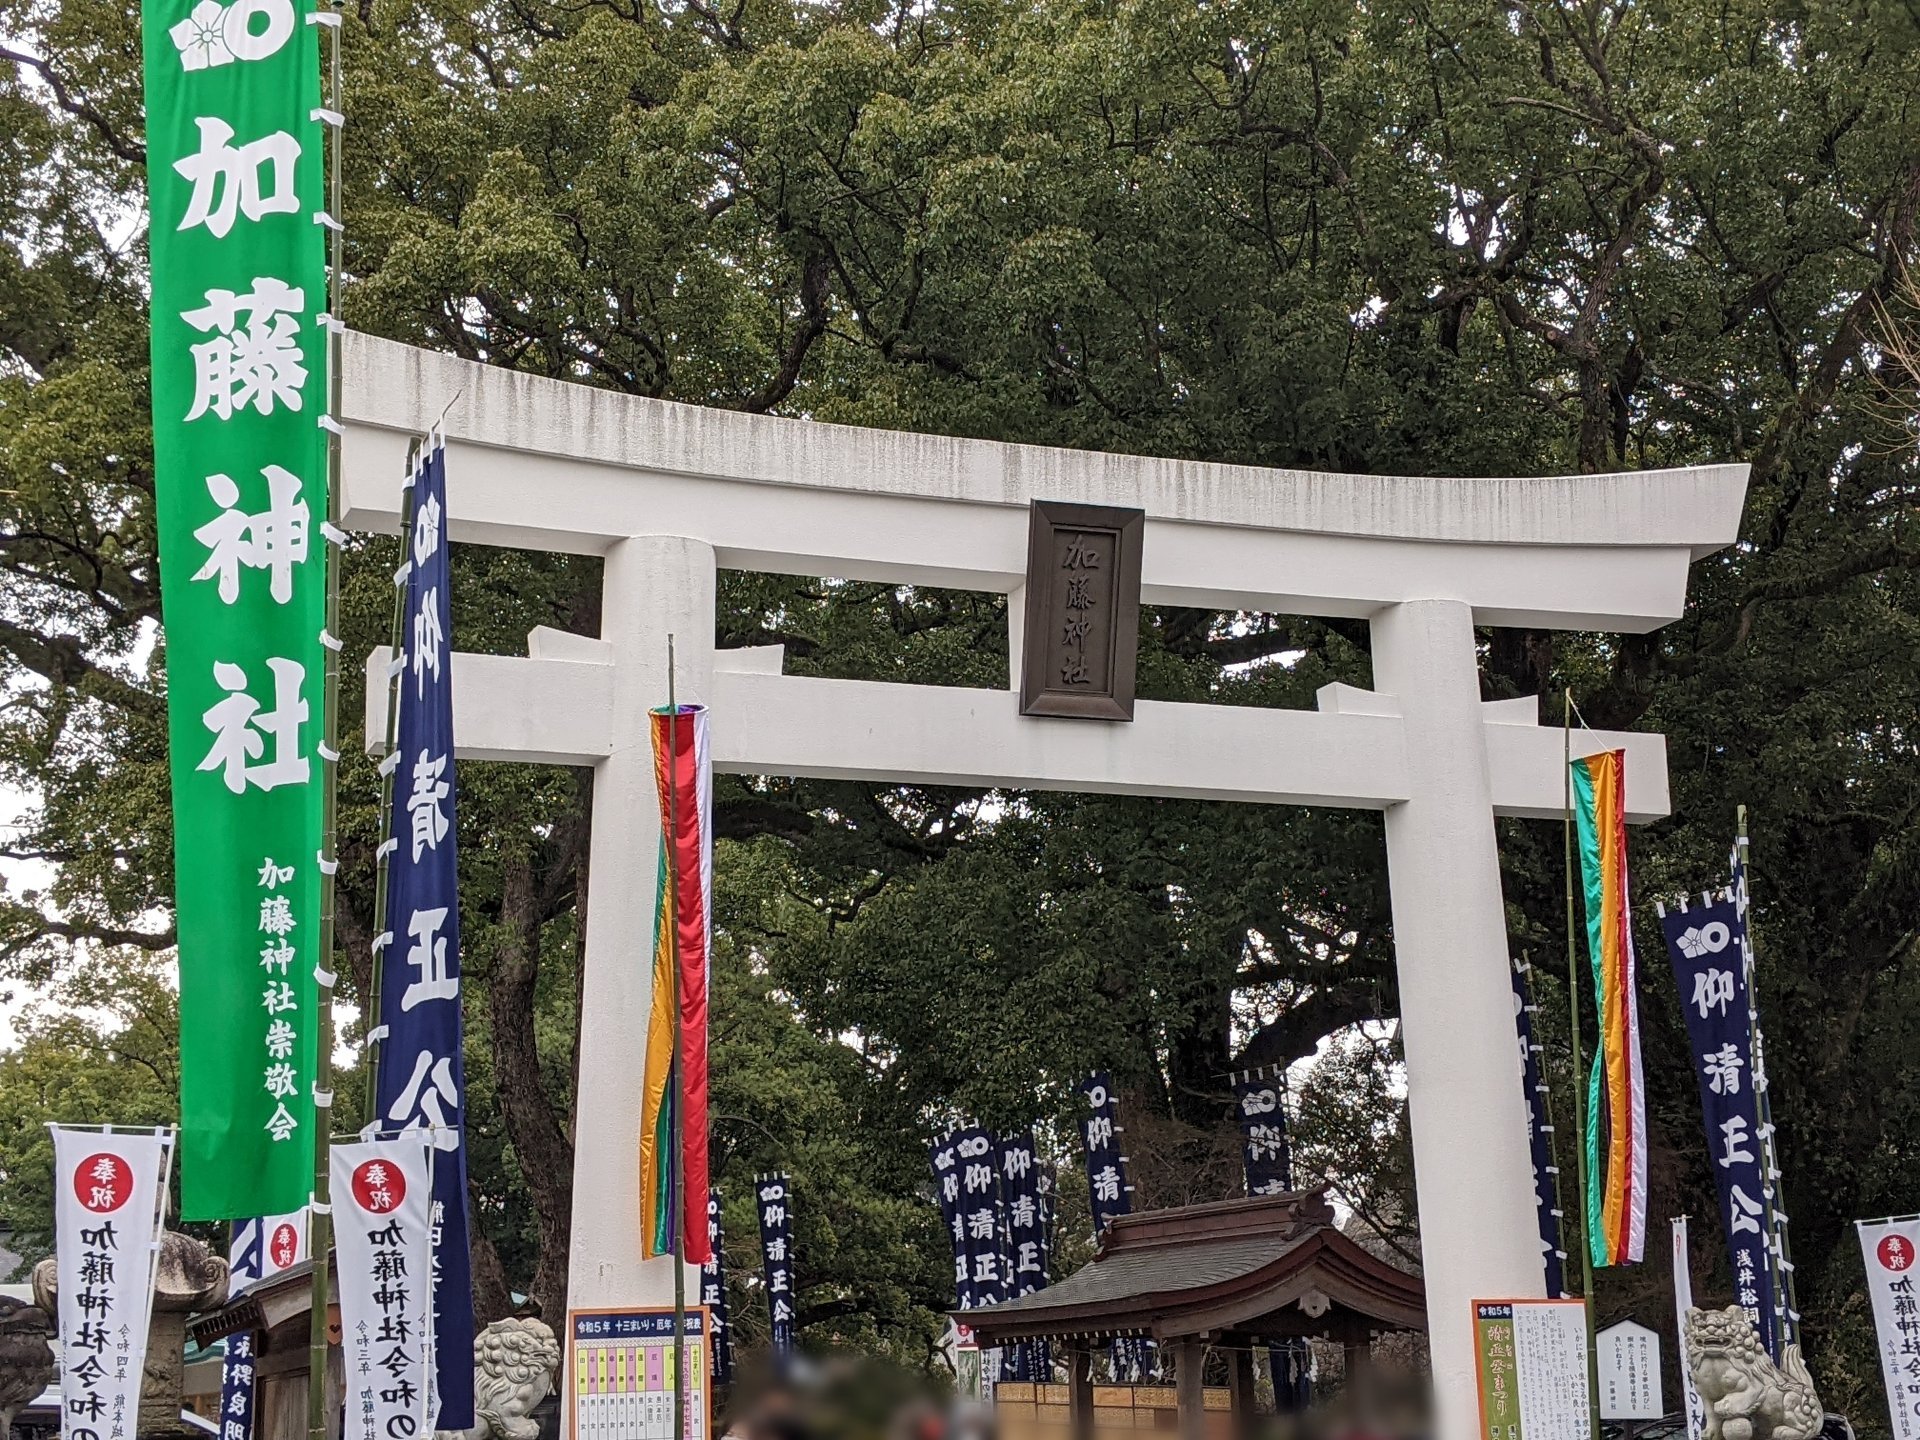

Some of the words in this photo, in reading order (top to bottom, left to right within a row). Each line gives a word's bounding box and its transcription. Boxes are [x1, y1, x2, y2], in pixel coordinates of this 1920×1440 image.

[172, 116, 310, 795] 加藤神社
[1062, 534, 1101, 684] 加藤神社
[257, 856, 299, 1142] 加藤神社崇敬会
[1690, 968, 1763, 1236] 仰清正公
[578, 1321, 611, 1334] 令和5年
[764, 1205, 791, 1322] 仰清正公
[1479, 1306, 1511, 1316] 令和5年
